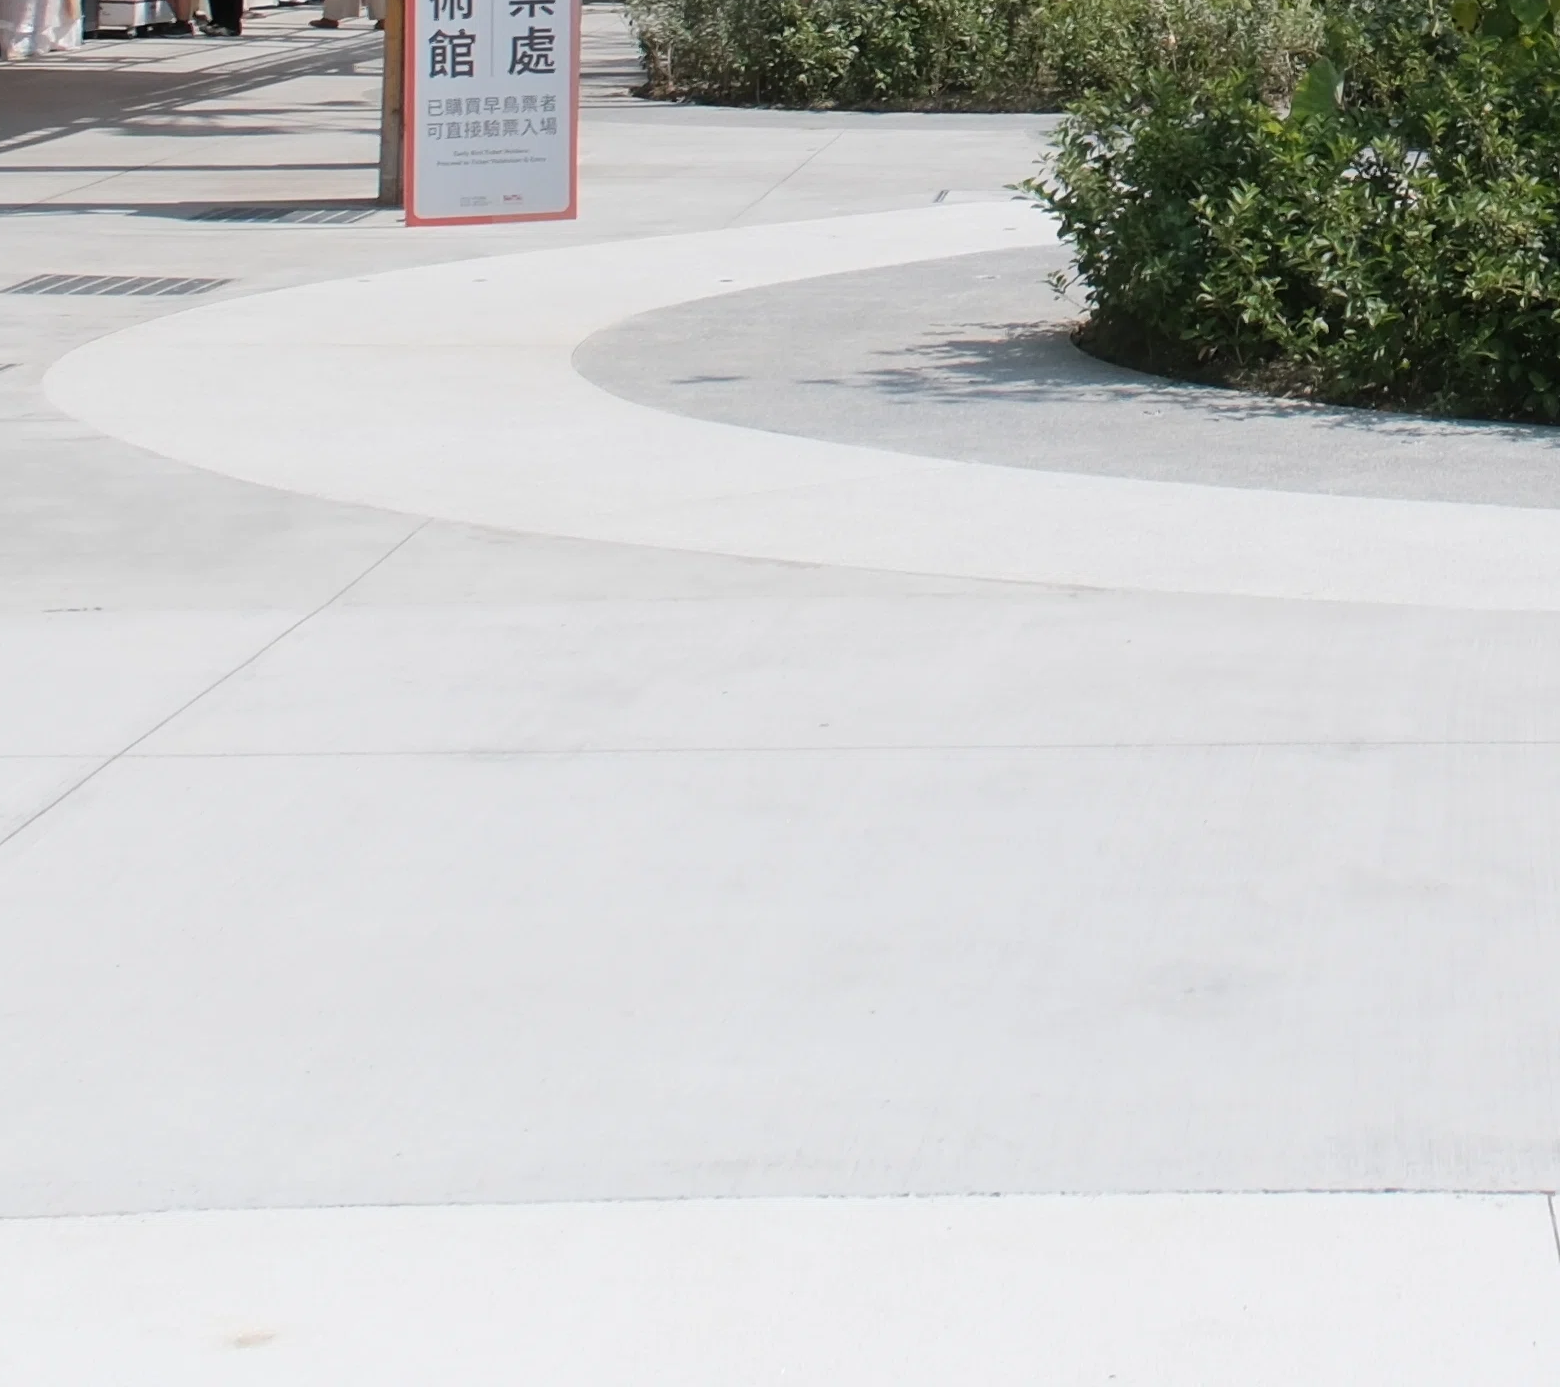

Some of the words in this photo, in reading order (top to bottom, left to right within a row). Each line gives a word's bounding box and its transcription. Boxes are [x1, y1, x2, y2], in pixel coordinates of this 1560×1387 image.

[427, 94, 557, 117] 已購買早鳥票者
[426, 117, 558, 140] 可直接驗票入場
